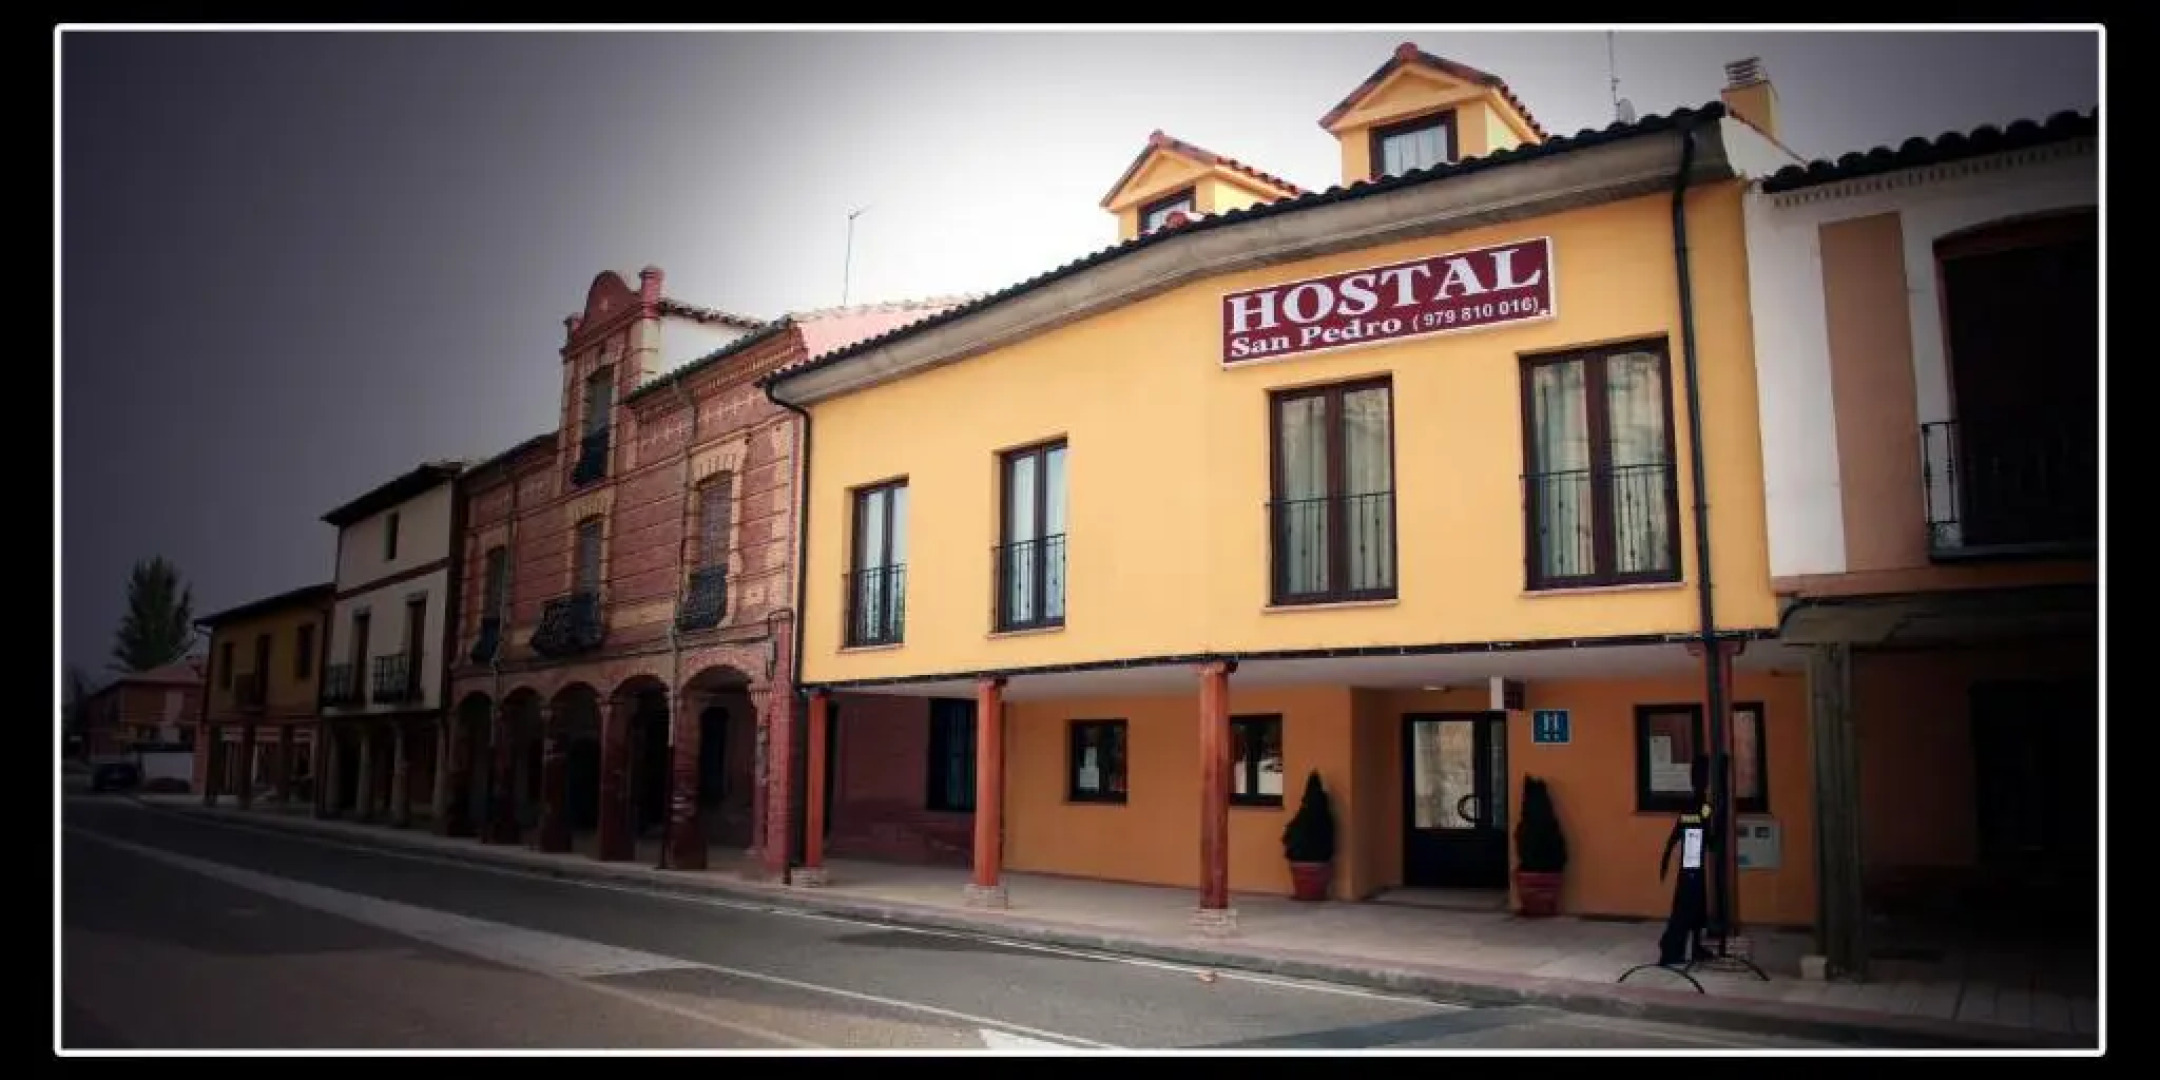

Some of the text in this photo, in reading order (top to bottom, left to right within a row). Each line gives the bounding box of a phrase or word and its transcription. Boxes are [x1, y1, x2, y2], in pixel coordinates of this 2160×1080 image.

[1227, 248, 1541, 334] HOSTAL
[1231, 336, 1290, 358] San
[1300, 318, 1401, 347] Pedro
[1461, 303, 1494, 322] 810
